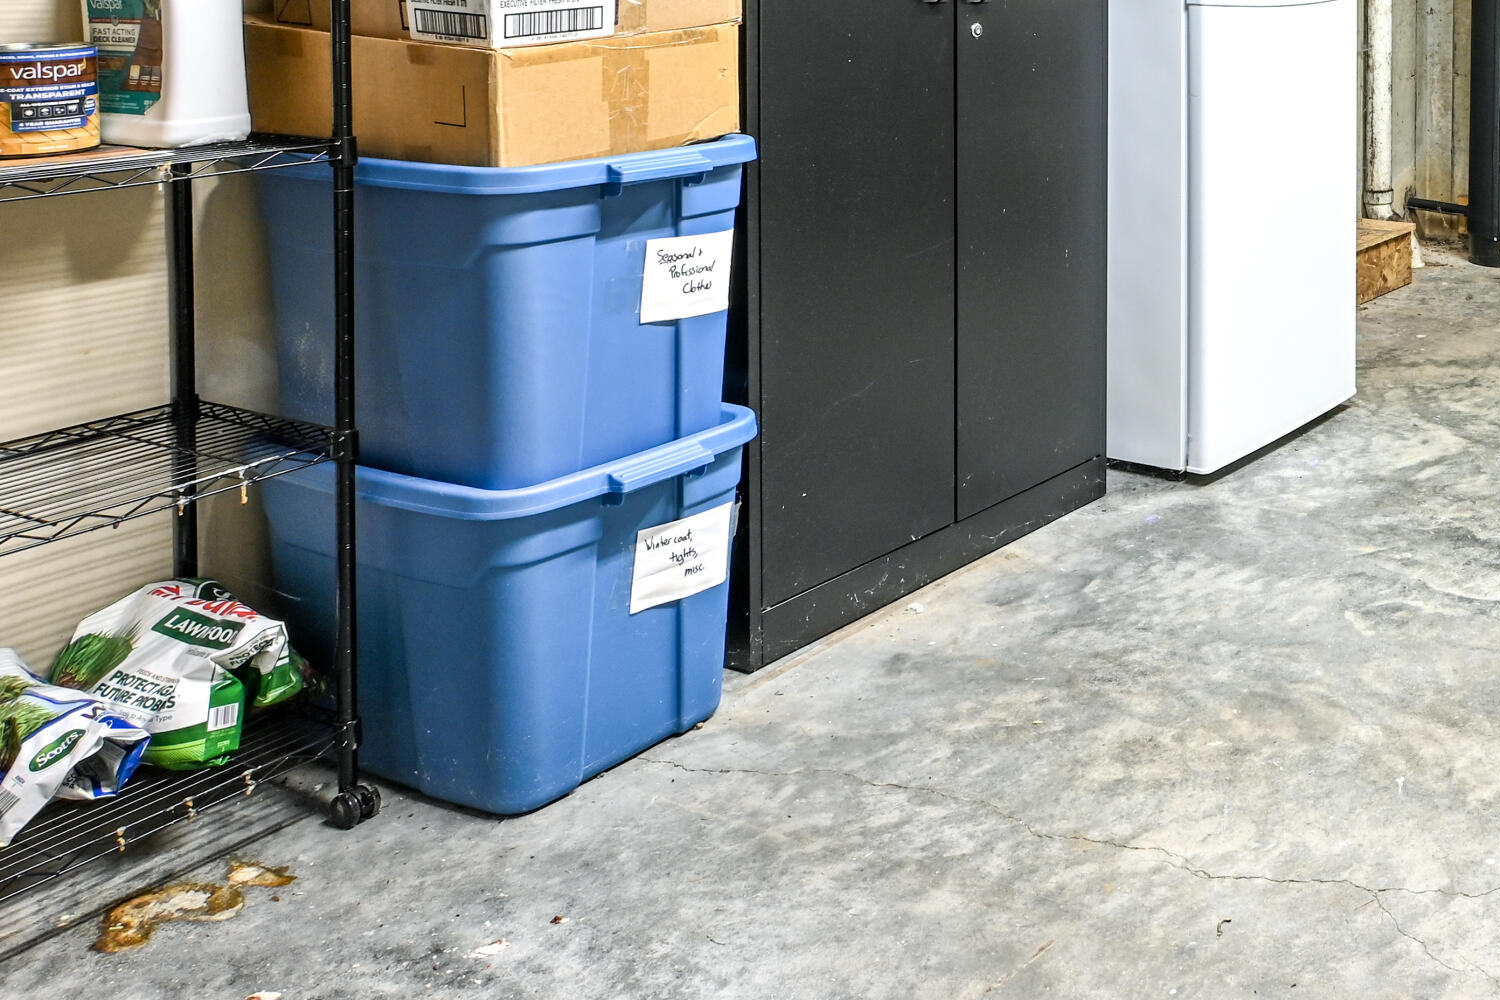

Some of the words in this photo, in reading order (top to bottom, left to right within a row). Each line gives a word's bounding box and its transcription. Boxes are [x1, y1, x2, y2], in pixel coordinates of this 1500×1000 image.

[499, 0, 528, 9] EXECUTIVE
[92, 27, 111, 36] FAST
[112, 28, 136, 36] ACTING
[111, 36, 136, 44] CLEANER
[9, 61, 82, 82] valspar
[9, 88, 86, 101] TRANSPARENT
[656, 246, 697, 262] Seasonal
[644, 535, 672, 551] Winter
[108, 669, 157, 693] PROTECT
[36, 731, 80, 768] Scotts
